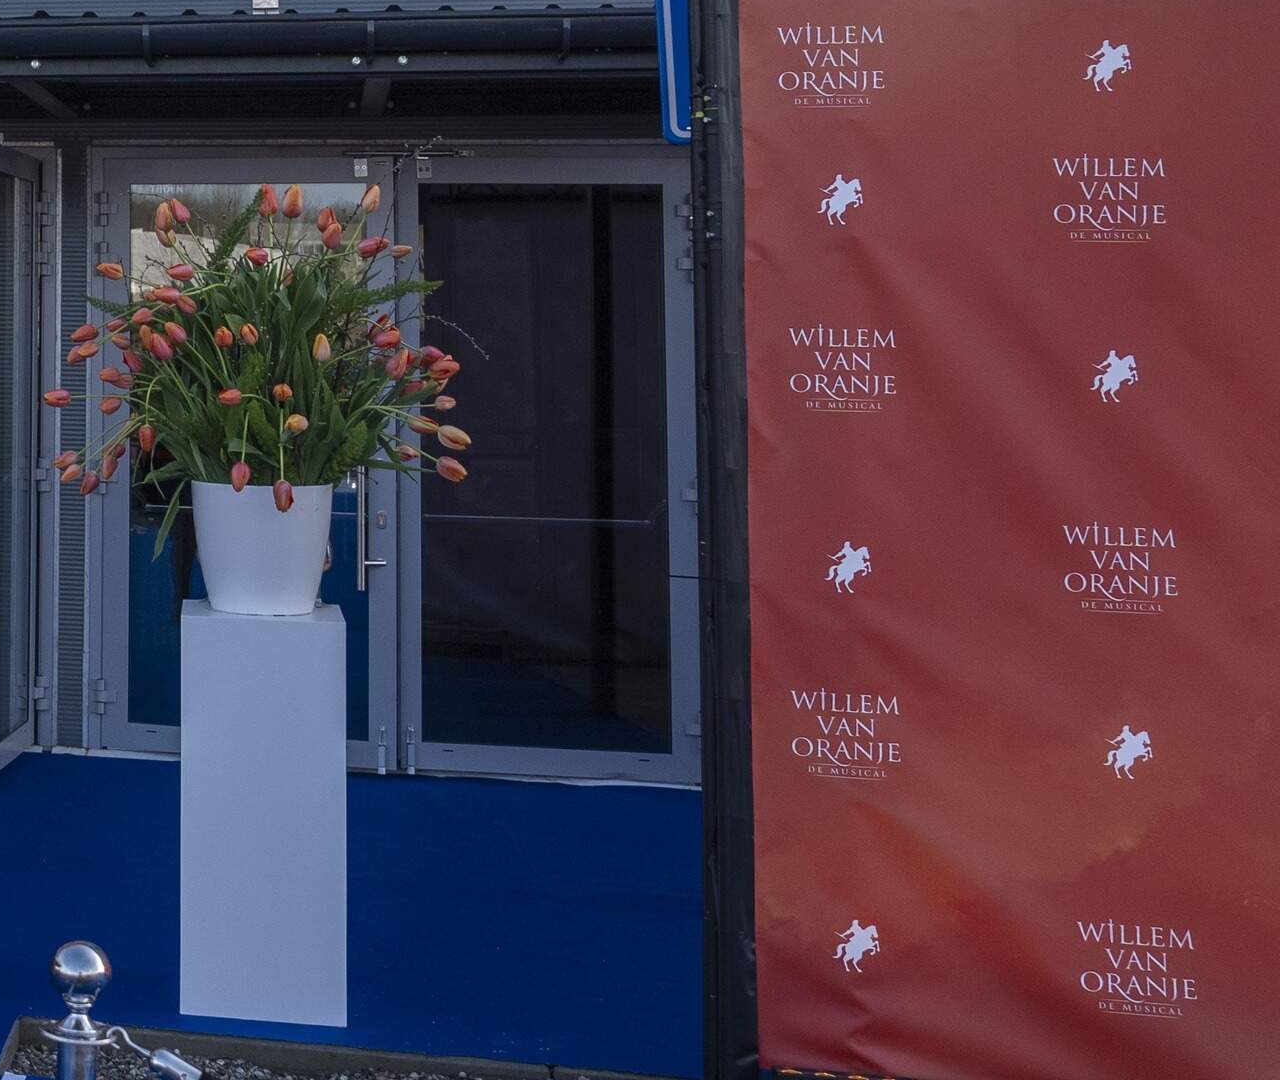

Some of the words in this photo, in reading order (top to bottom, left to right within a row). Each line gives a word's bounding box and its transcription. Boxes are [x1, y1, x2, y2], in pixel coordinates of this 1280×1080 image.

[777, 22, 885, 46] WILLEM
[802, 48, 860, 68] VAN
[778, 70, 886, 96] ORANJE
[794, 97, 810, 106] DE
[815, 96, 872, 106] MUSICAL
[1053, 153, 1166, 178] WILLEM
[1078, 181, 1139, 201] VAN
[1053, 203, 1167, 230] ORANJE
[1070, 232, 1088, 240] DE
[1093, 232, 1152, 240] MUSICAL
[789, 322, 896, 348] WILLEM
[814, 350, 871, 371] VAN
[789, 372, 897, 400] ORANJE
[806, 401, 822, 409] DE
[828, 402, 883, 410] MUSICAL
[1062, 521, 1176, 548] WILLEM
[1089, 550, 1150, 572] VAN
[1063, 572, 1178, 600] ORANJE
[1081, 600, 1098, 609] DE
[1104, 602, 1164, 612] MUSICAL
[790, 688, 900, 716] WILLEM
[816, 716, 876, 738] VAN
[791, 737, 902, 767] ORANJE
[808, 766, 824, 774] DE
[830, 767, 888, 778] MUSICAL
[1077, 919, 1195, 950] WILLEM
[1105, 949, 1168, 972] VAN
[1080, 970, 1198, 1003] ORANJE
[1098, 1001, 1116, 1010] DE
[1122, 1003, 1184, 1016] MUSICAL
